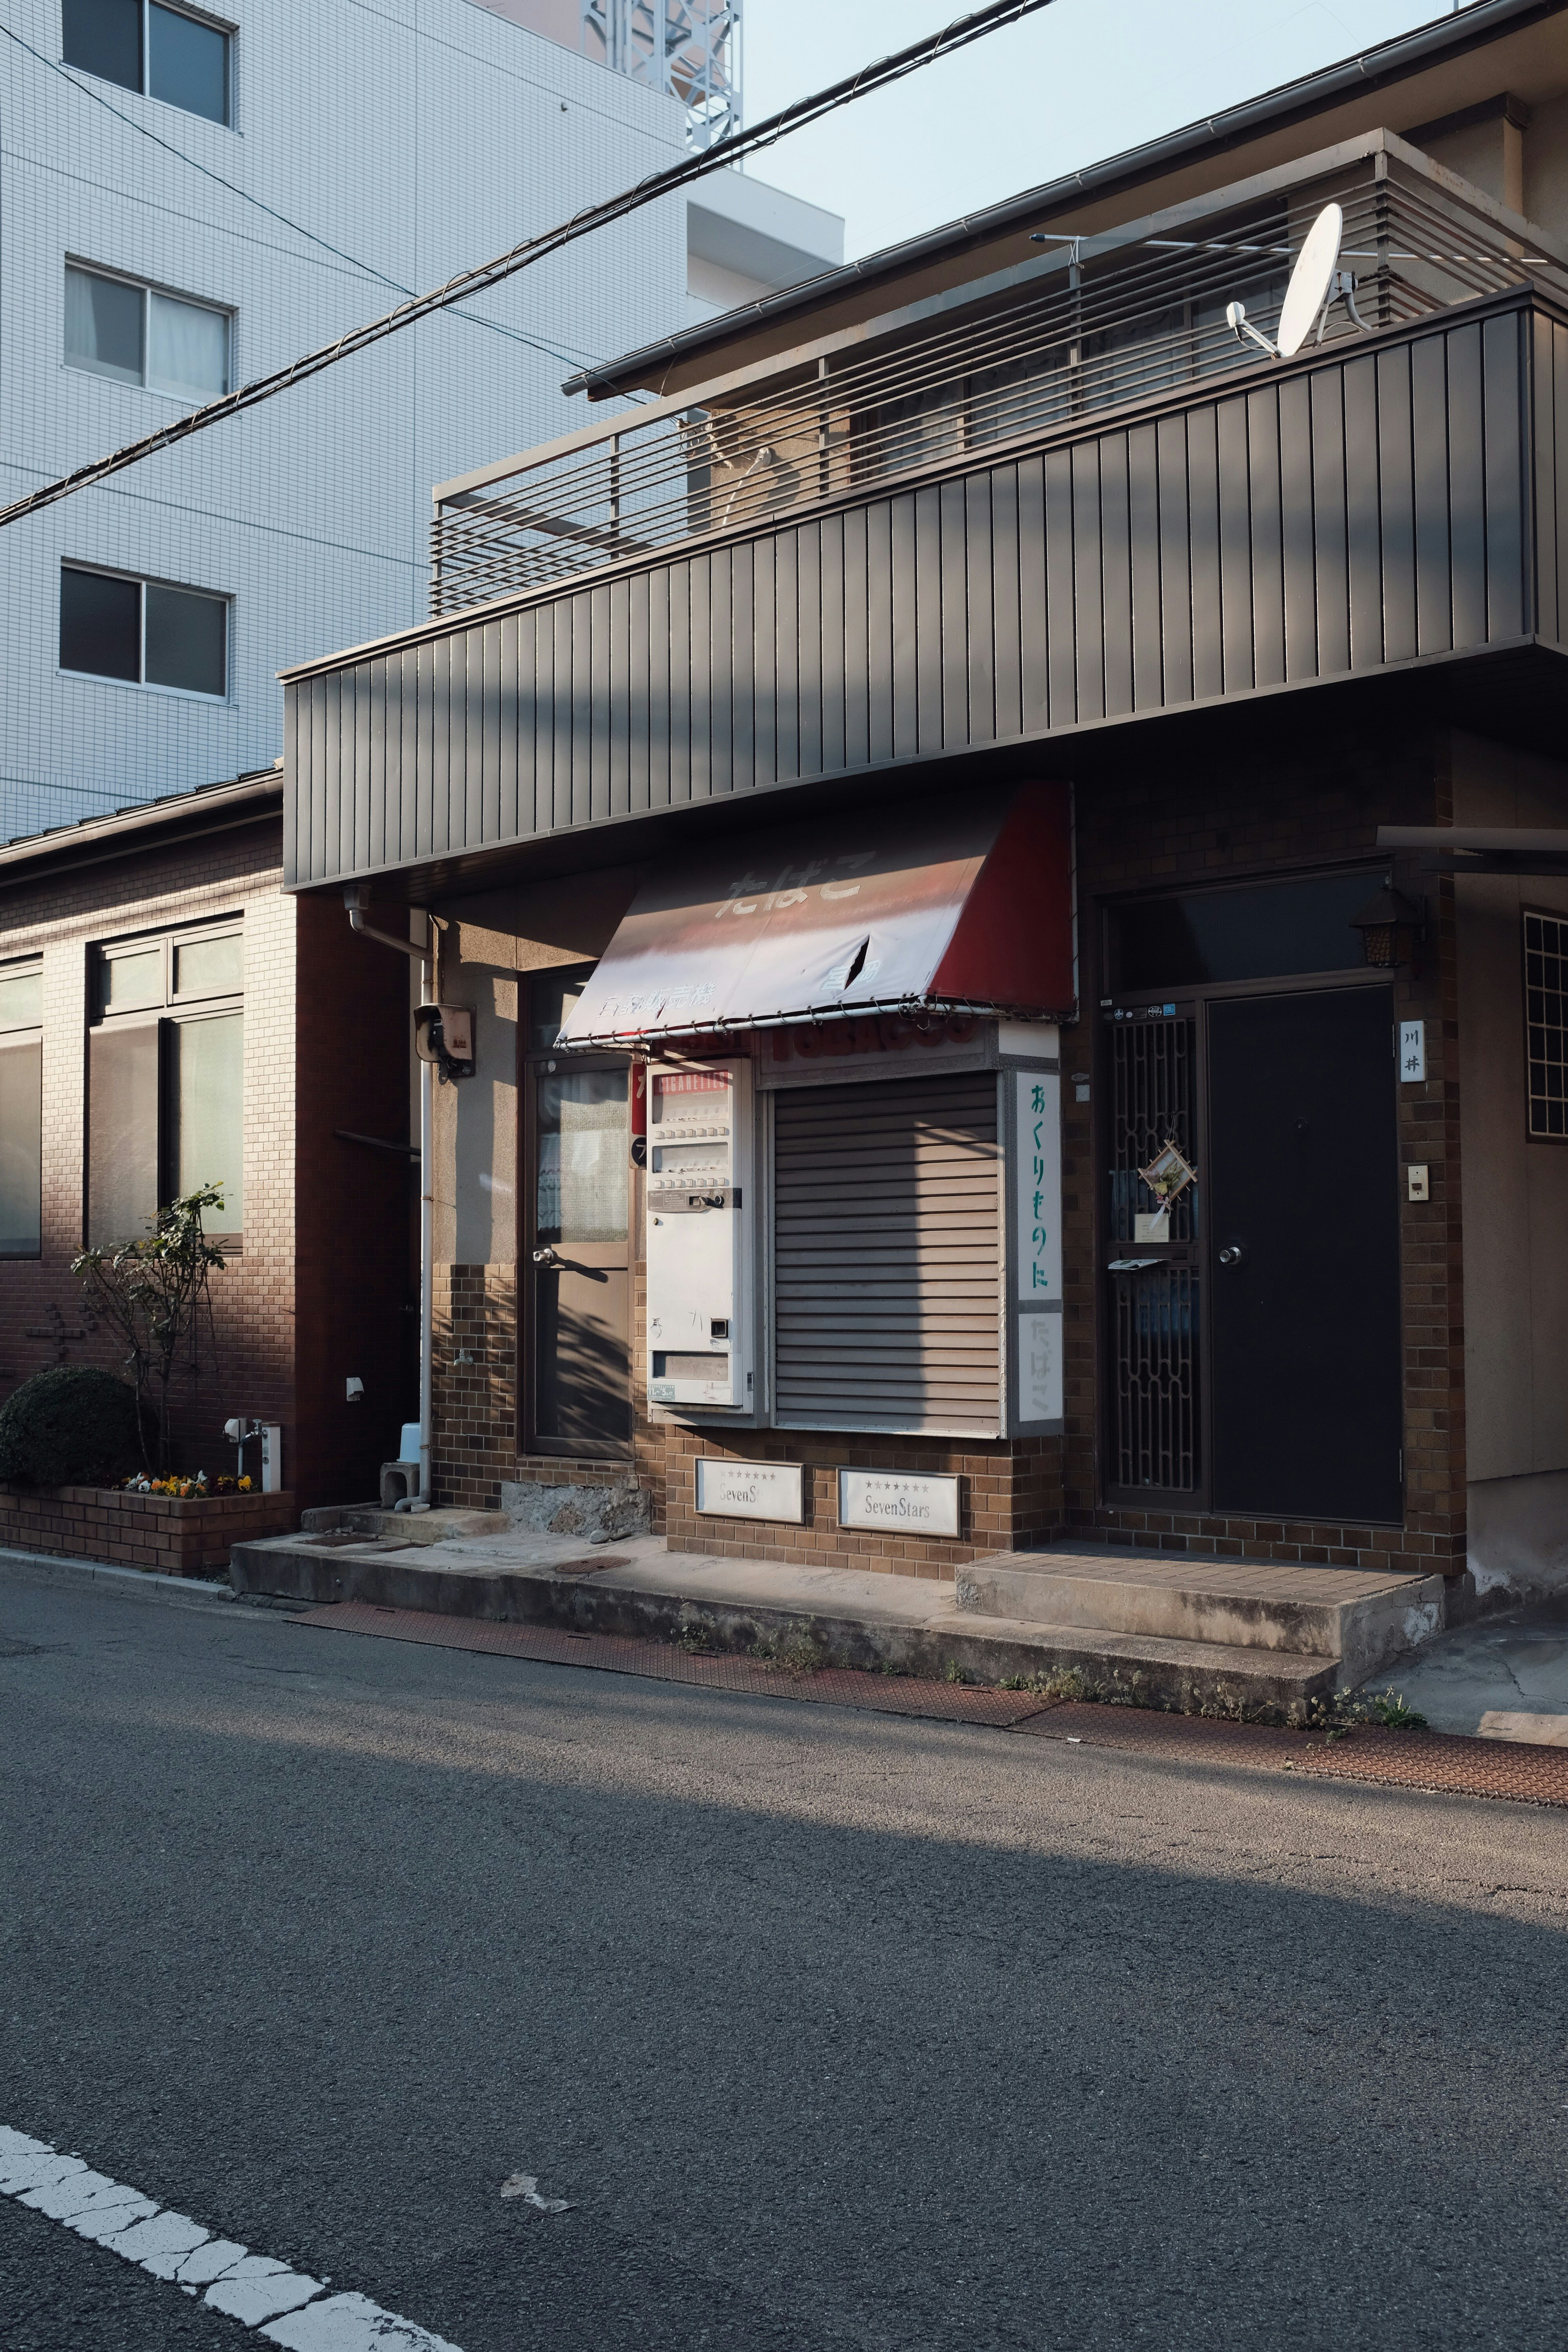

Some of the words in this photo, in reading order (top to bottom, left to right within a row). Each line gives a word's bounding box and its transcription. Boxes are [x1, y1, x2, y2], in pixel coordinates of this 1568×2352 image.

[715, 850, 876, 919] たばこ
[596, 981, 718, 1018] 自動販売機
[1405, 1030, 1420, 1073] 川井
[659, 1072, 725, 1092] CIGARETTES
[1031, 1084, 1048, 1289] おくりものに
[1030, 1319, 1050, 1411] たばこ
